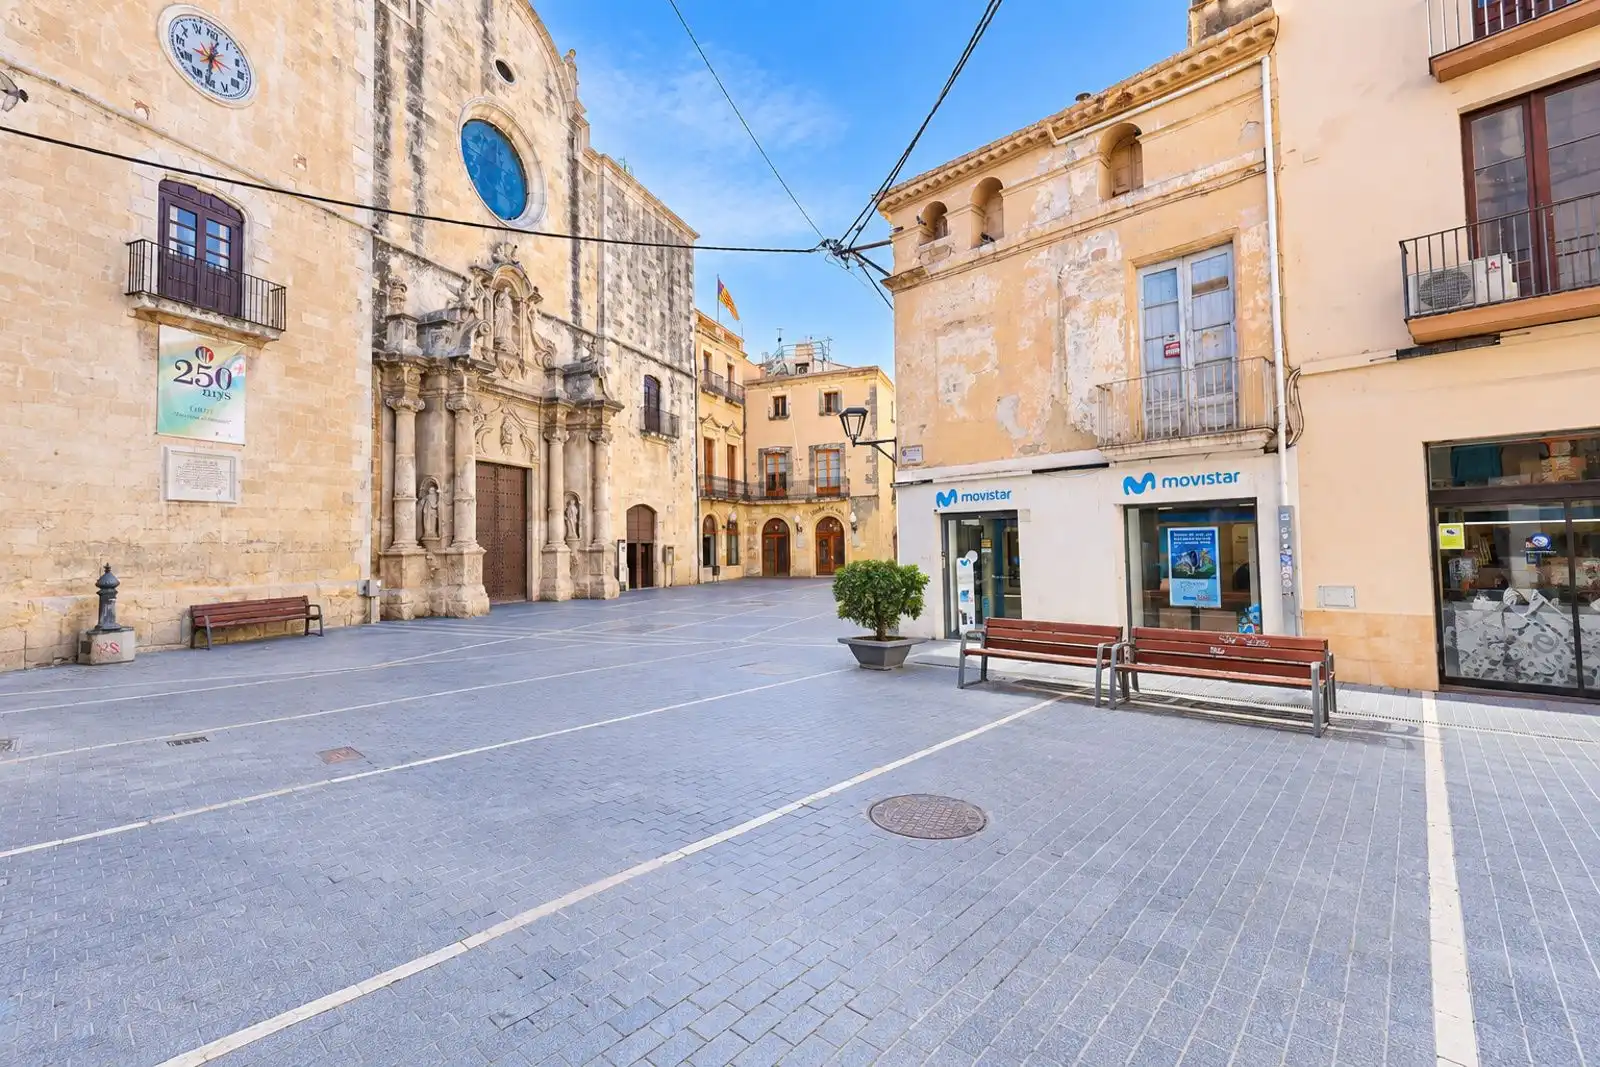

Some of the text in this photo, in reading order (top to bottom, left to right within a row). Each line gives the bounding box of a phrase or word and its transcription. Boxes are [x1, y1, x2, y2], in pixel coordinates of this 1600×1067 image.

[173, 359, 232, 391] 250
[1162, 471, 1241, 488] movistar
[961, 489, 1012, 502] movistar
